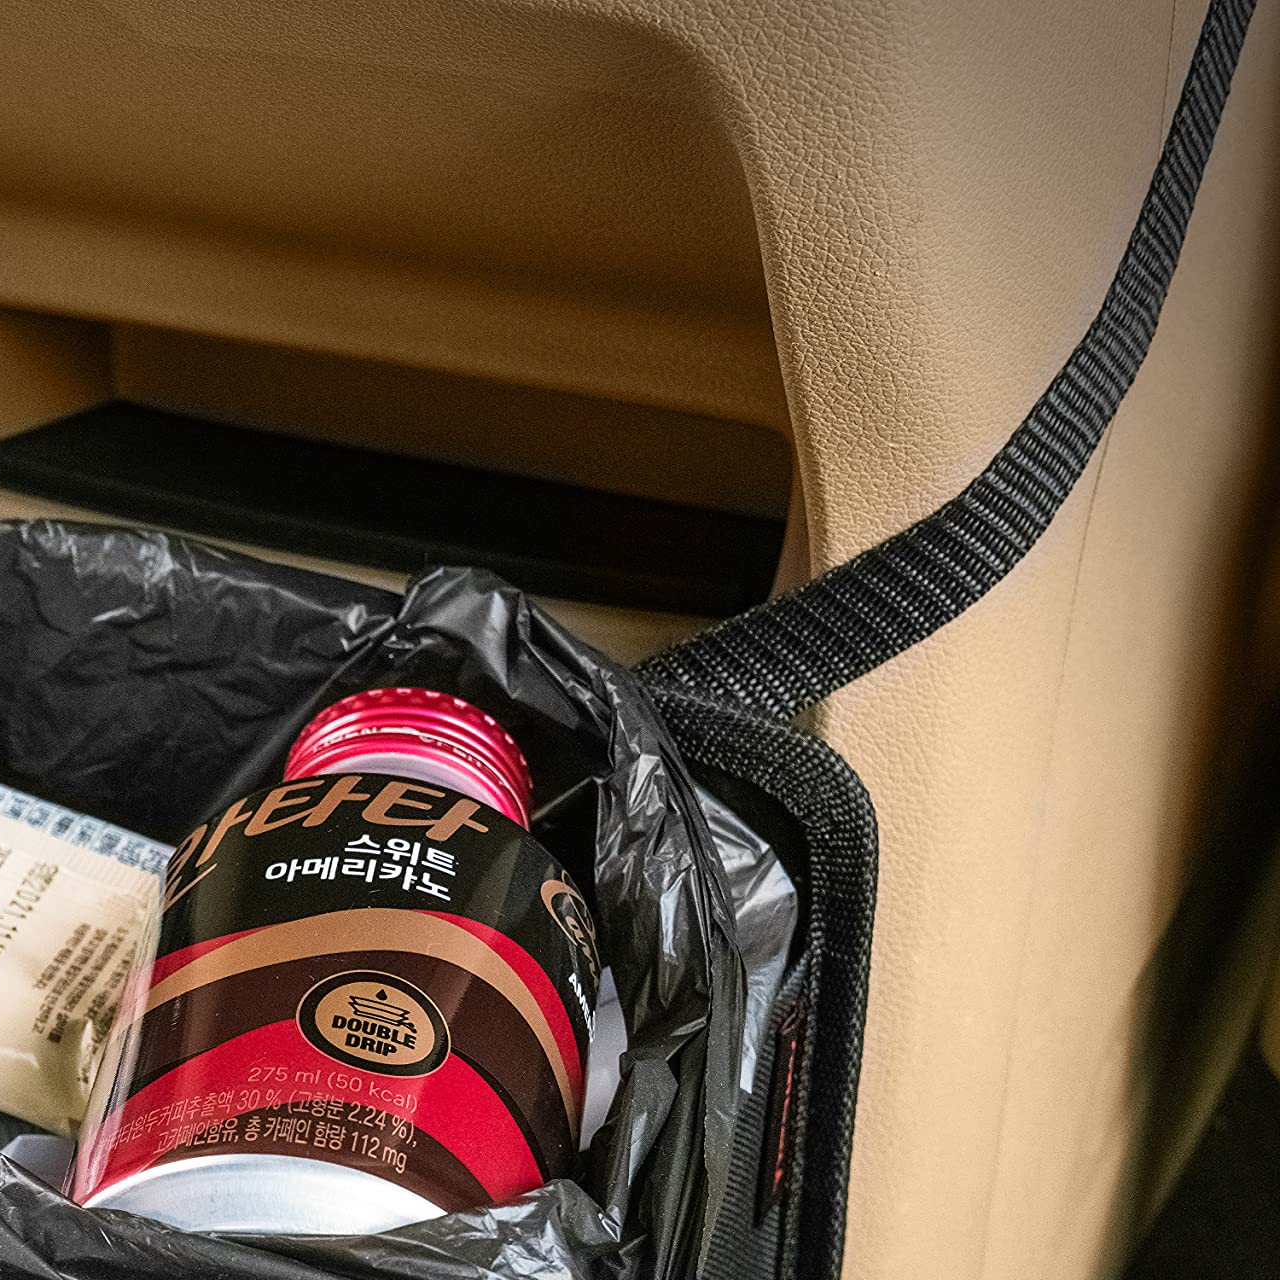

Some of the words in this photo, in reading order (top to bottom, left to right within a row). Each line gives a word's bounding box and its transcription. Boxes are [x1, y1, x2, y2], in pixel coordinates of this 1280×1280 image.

[264, 854, 452, 902] 아메리카노
[344, 834, 457, 877] 스위트
[331, 1014, 417, 1050] DOUBLE
[344, 1033, 398, 1057] DRIP
[247, 1066, 289, 1082] 275
[294, 1069, 322, 1084] ml
[327, 1071, 362, 1093] (50
[368, 1081, 418, 1114] kcal)
[236, 1089, 261, 1110] 30
[265, 1089, 282, 1111] %
[287, 1089, 345, 1120] (고형분
[347, 1101, 388, 1131] 2.24
[391, 1114, 418, 1148] %),
[152, 1117, 239, 1154] 고카페인함유,
[244, 1115, 262, 1142] 총
[263, 1116, 312, 1144] 카페인
[313, 1121, 348, 1151] 함량
[351, 1131, 381, 1159] 112
[382, 1146, 408, 1174] mg
